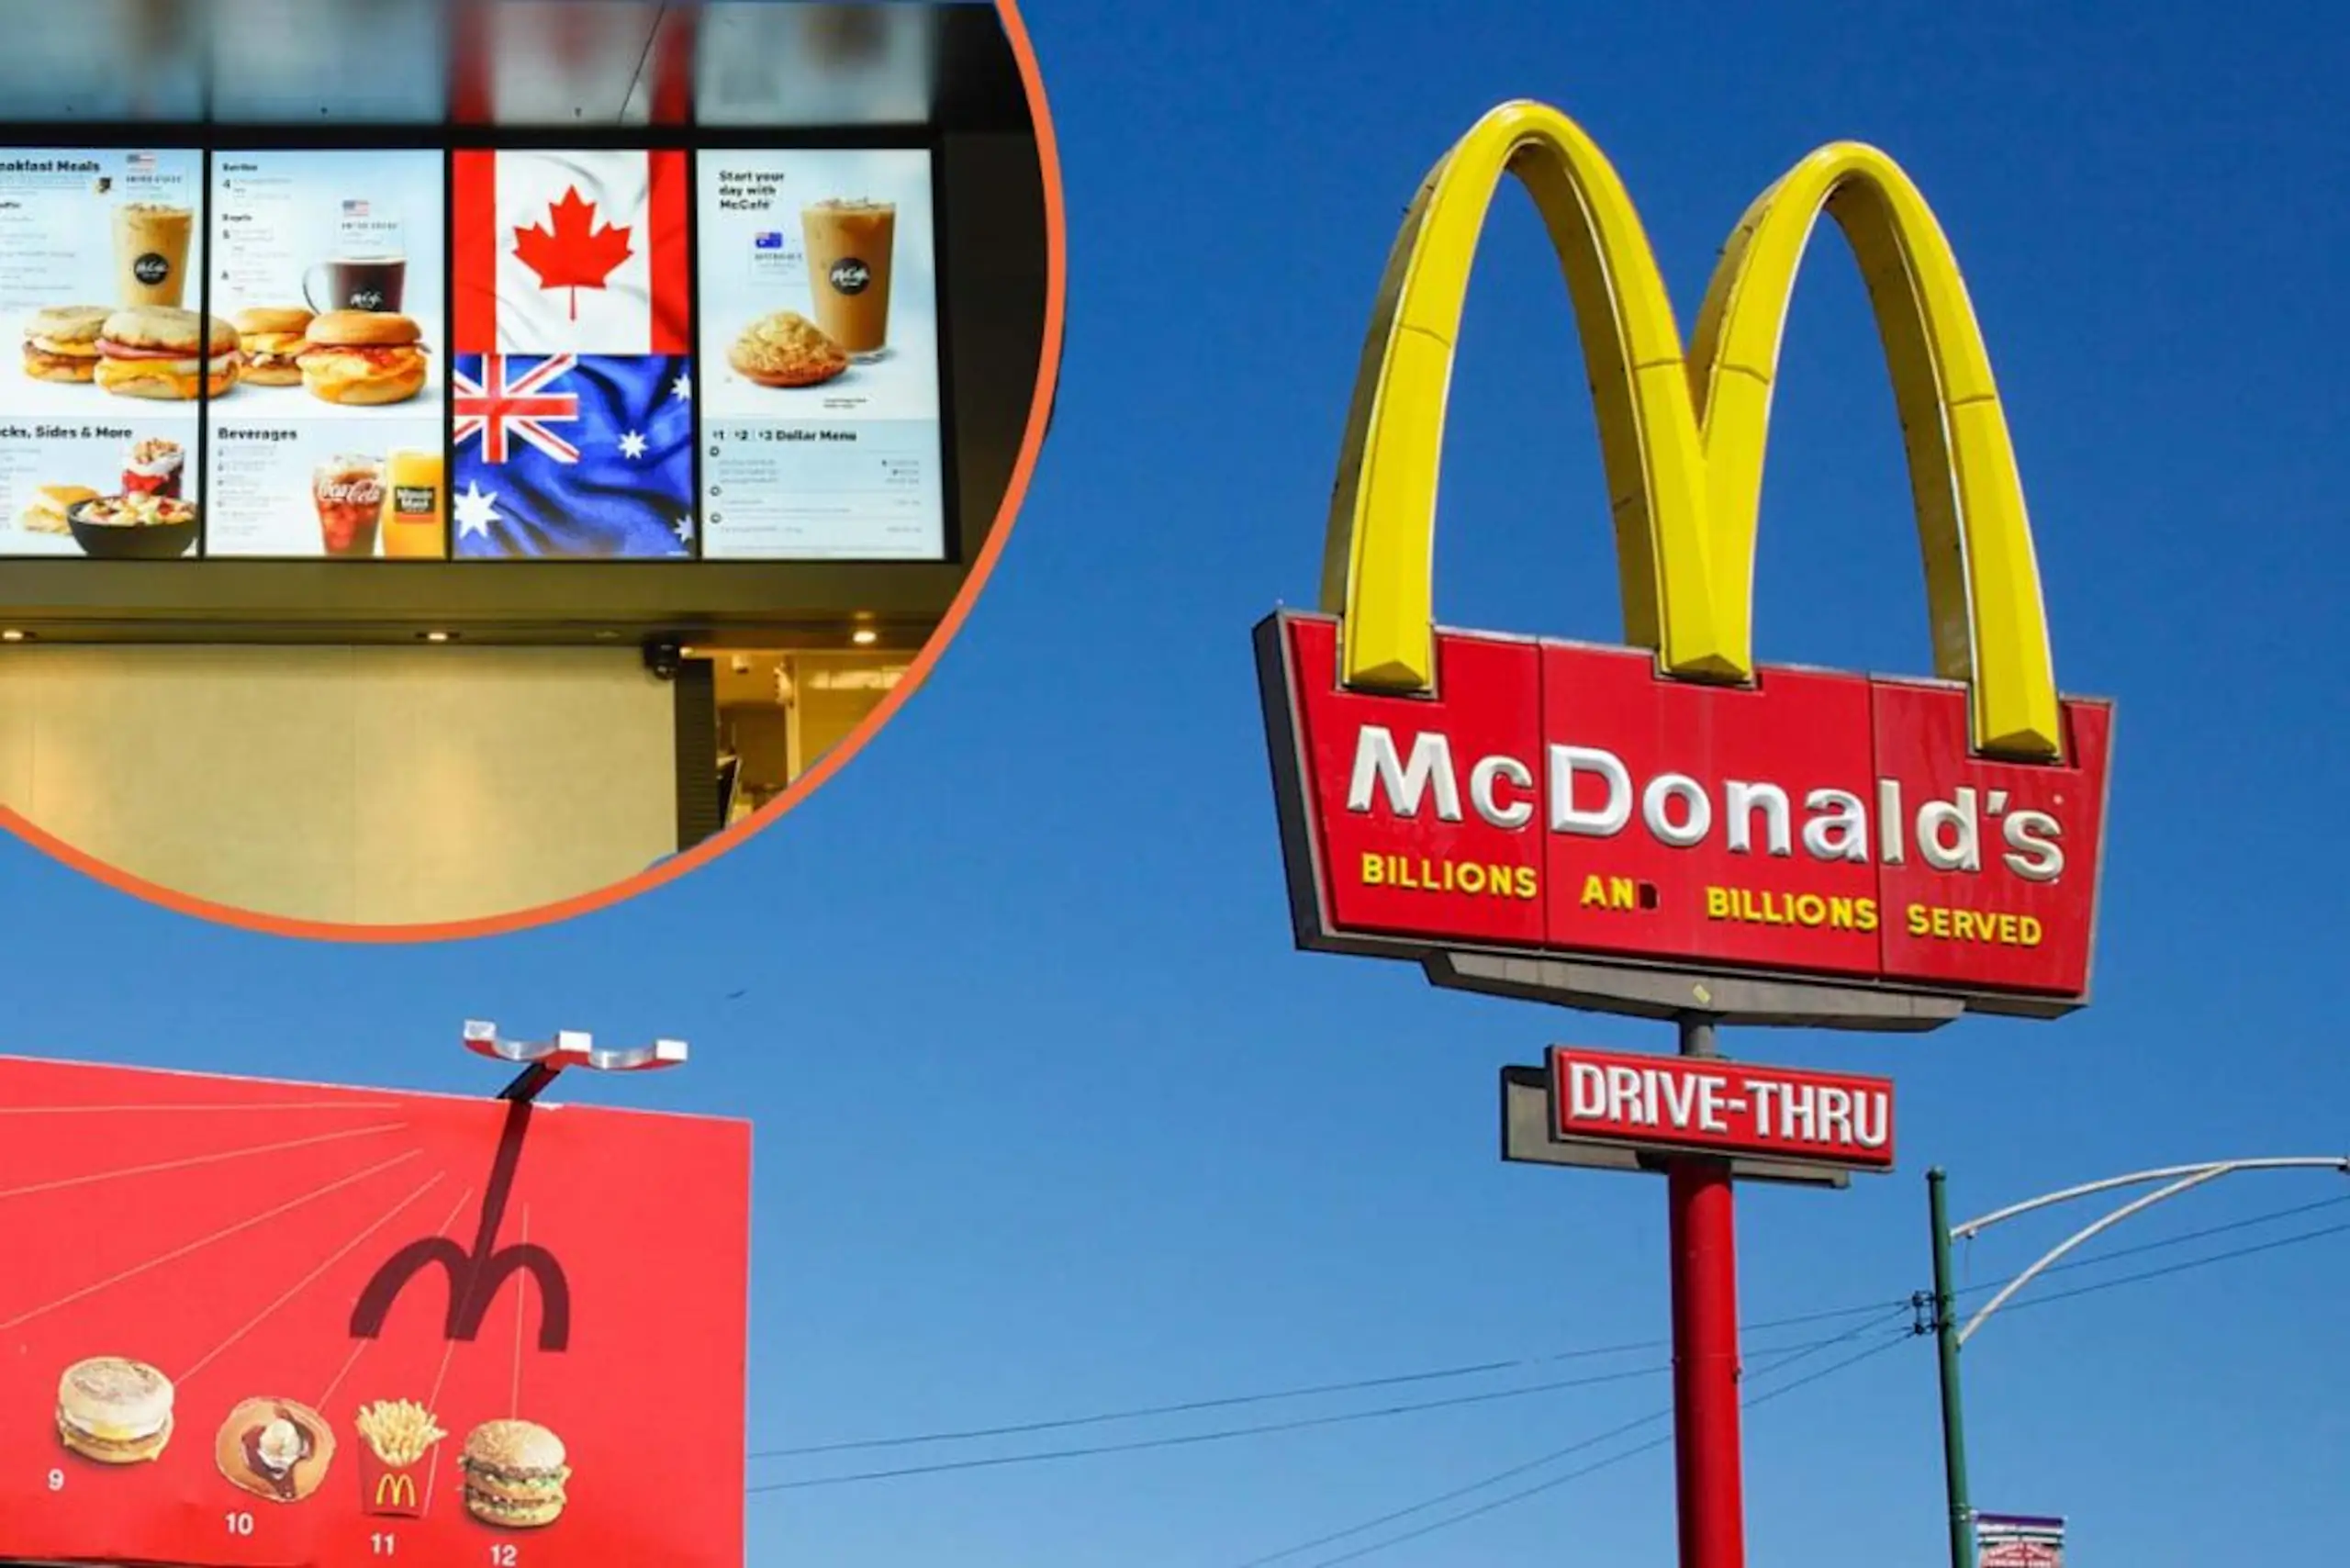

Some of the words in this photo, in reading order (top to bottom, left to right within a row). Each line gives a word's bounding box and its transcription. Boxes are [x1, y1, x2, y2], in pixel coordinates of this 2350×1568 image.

[57, 160, 100, 173] Meals
[719, 171, 751, 182] Start
[755, 173, 784, 185] your
[719, 185, 743, 196] day
[746, 185, 777, 196] with
[36, 425, 77, 439] Sides
[81, 426, 92, 438] &
[96, 426, 133, 439] More
[218, 427, 297, 442] Beverages
[777, 430, 816, 442] Dollar
[820, 431, 857, 442] Menu
[1347, 724, 2065, 881] McDonald's
[1361, 853, 1538, 899] BILLIONS
[1706, 886, 1879, 931] BILLIONS
[1907, 903, 2042, 946] SERVED
[1569, 1061, 1888, 1148] DRIVE-THRU
[48, 1471, 64, 1492] 9
[225, 1512, 254, 1536] 10
[371, 1532, 396, 1556] 11
[489, 1545, 519, 1567] 12
